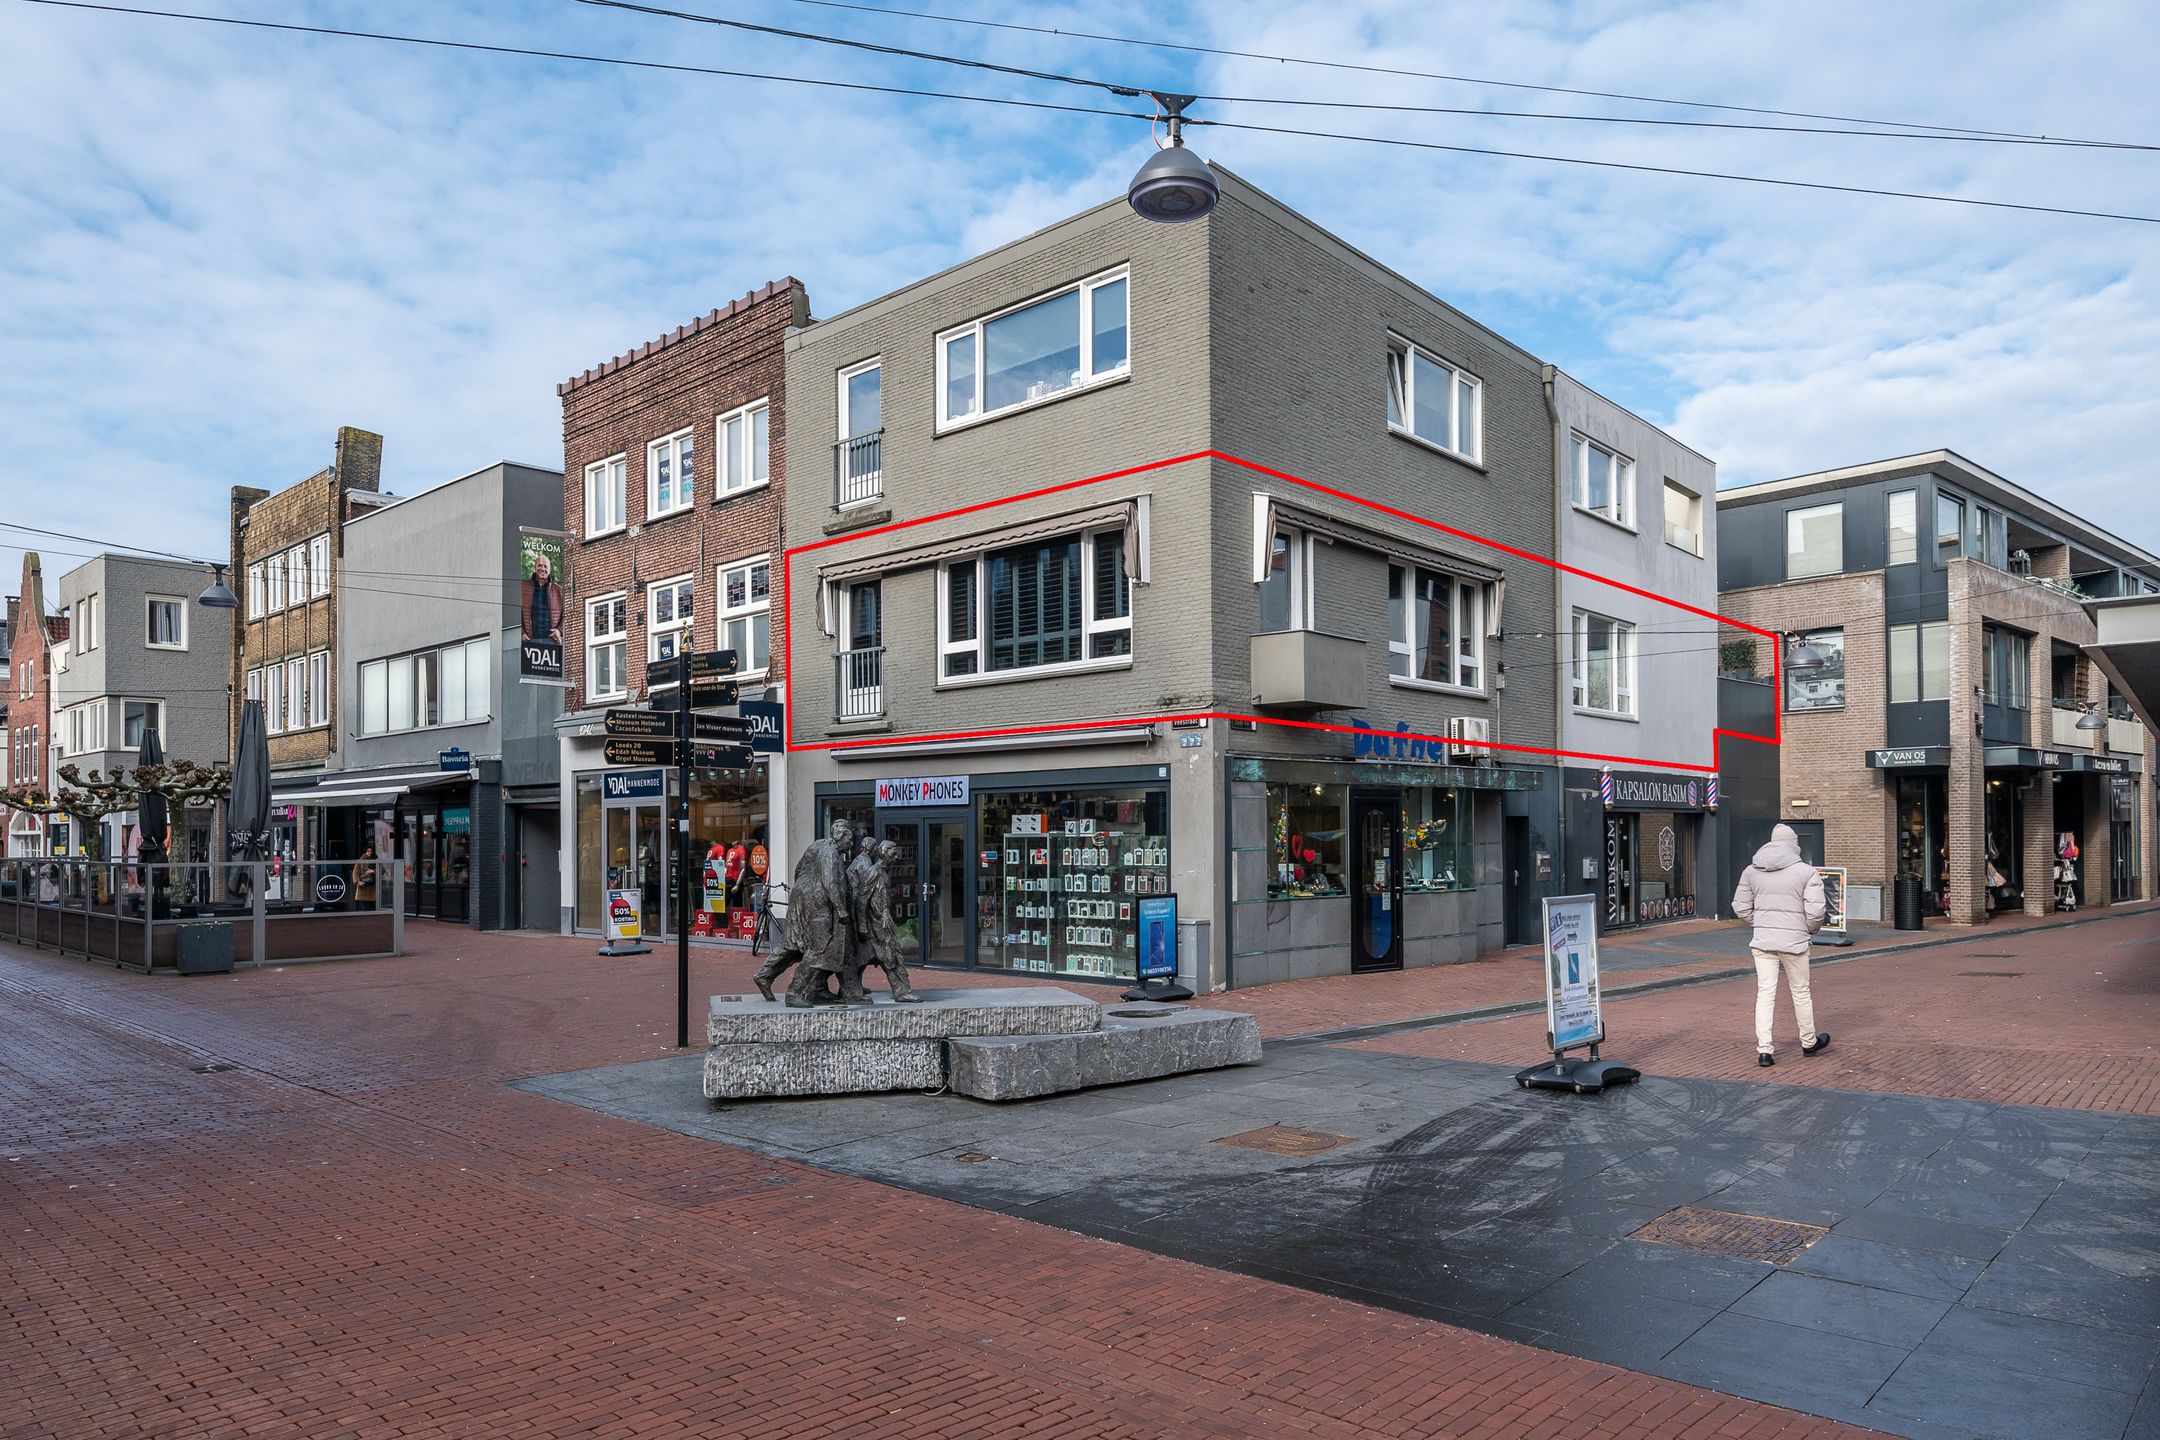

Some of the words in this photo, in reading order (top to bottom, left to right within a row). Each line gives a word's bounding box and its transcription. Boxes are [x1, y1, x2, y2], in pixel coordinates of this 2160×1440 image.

[523, 541, 561, 553] WELKOM
[1350, 716, 1443, 761] Dafne
[441, 754, 469, 763] Bavaria
[1893, 752, 1912, 760] VAN
[1913, 751, 1926, 760] OS
[627, 778, 660, 787] MANNENMODE
[879, 783, 921, 802] MONKEY
[922, 781, 964, 801] PHONES
[1616, 780, 1661, 801] KAPSALON
[1662, 784, 1688, 803] BASIM
[752, 854, 766, 865] 10%
[1607, 818, 1617, 922] WELKOM
[706, 878, 718, 887] 50%
[614, 907, 630, 916] 50%
